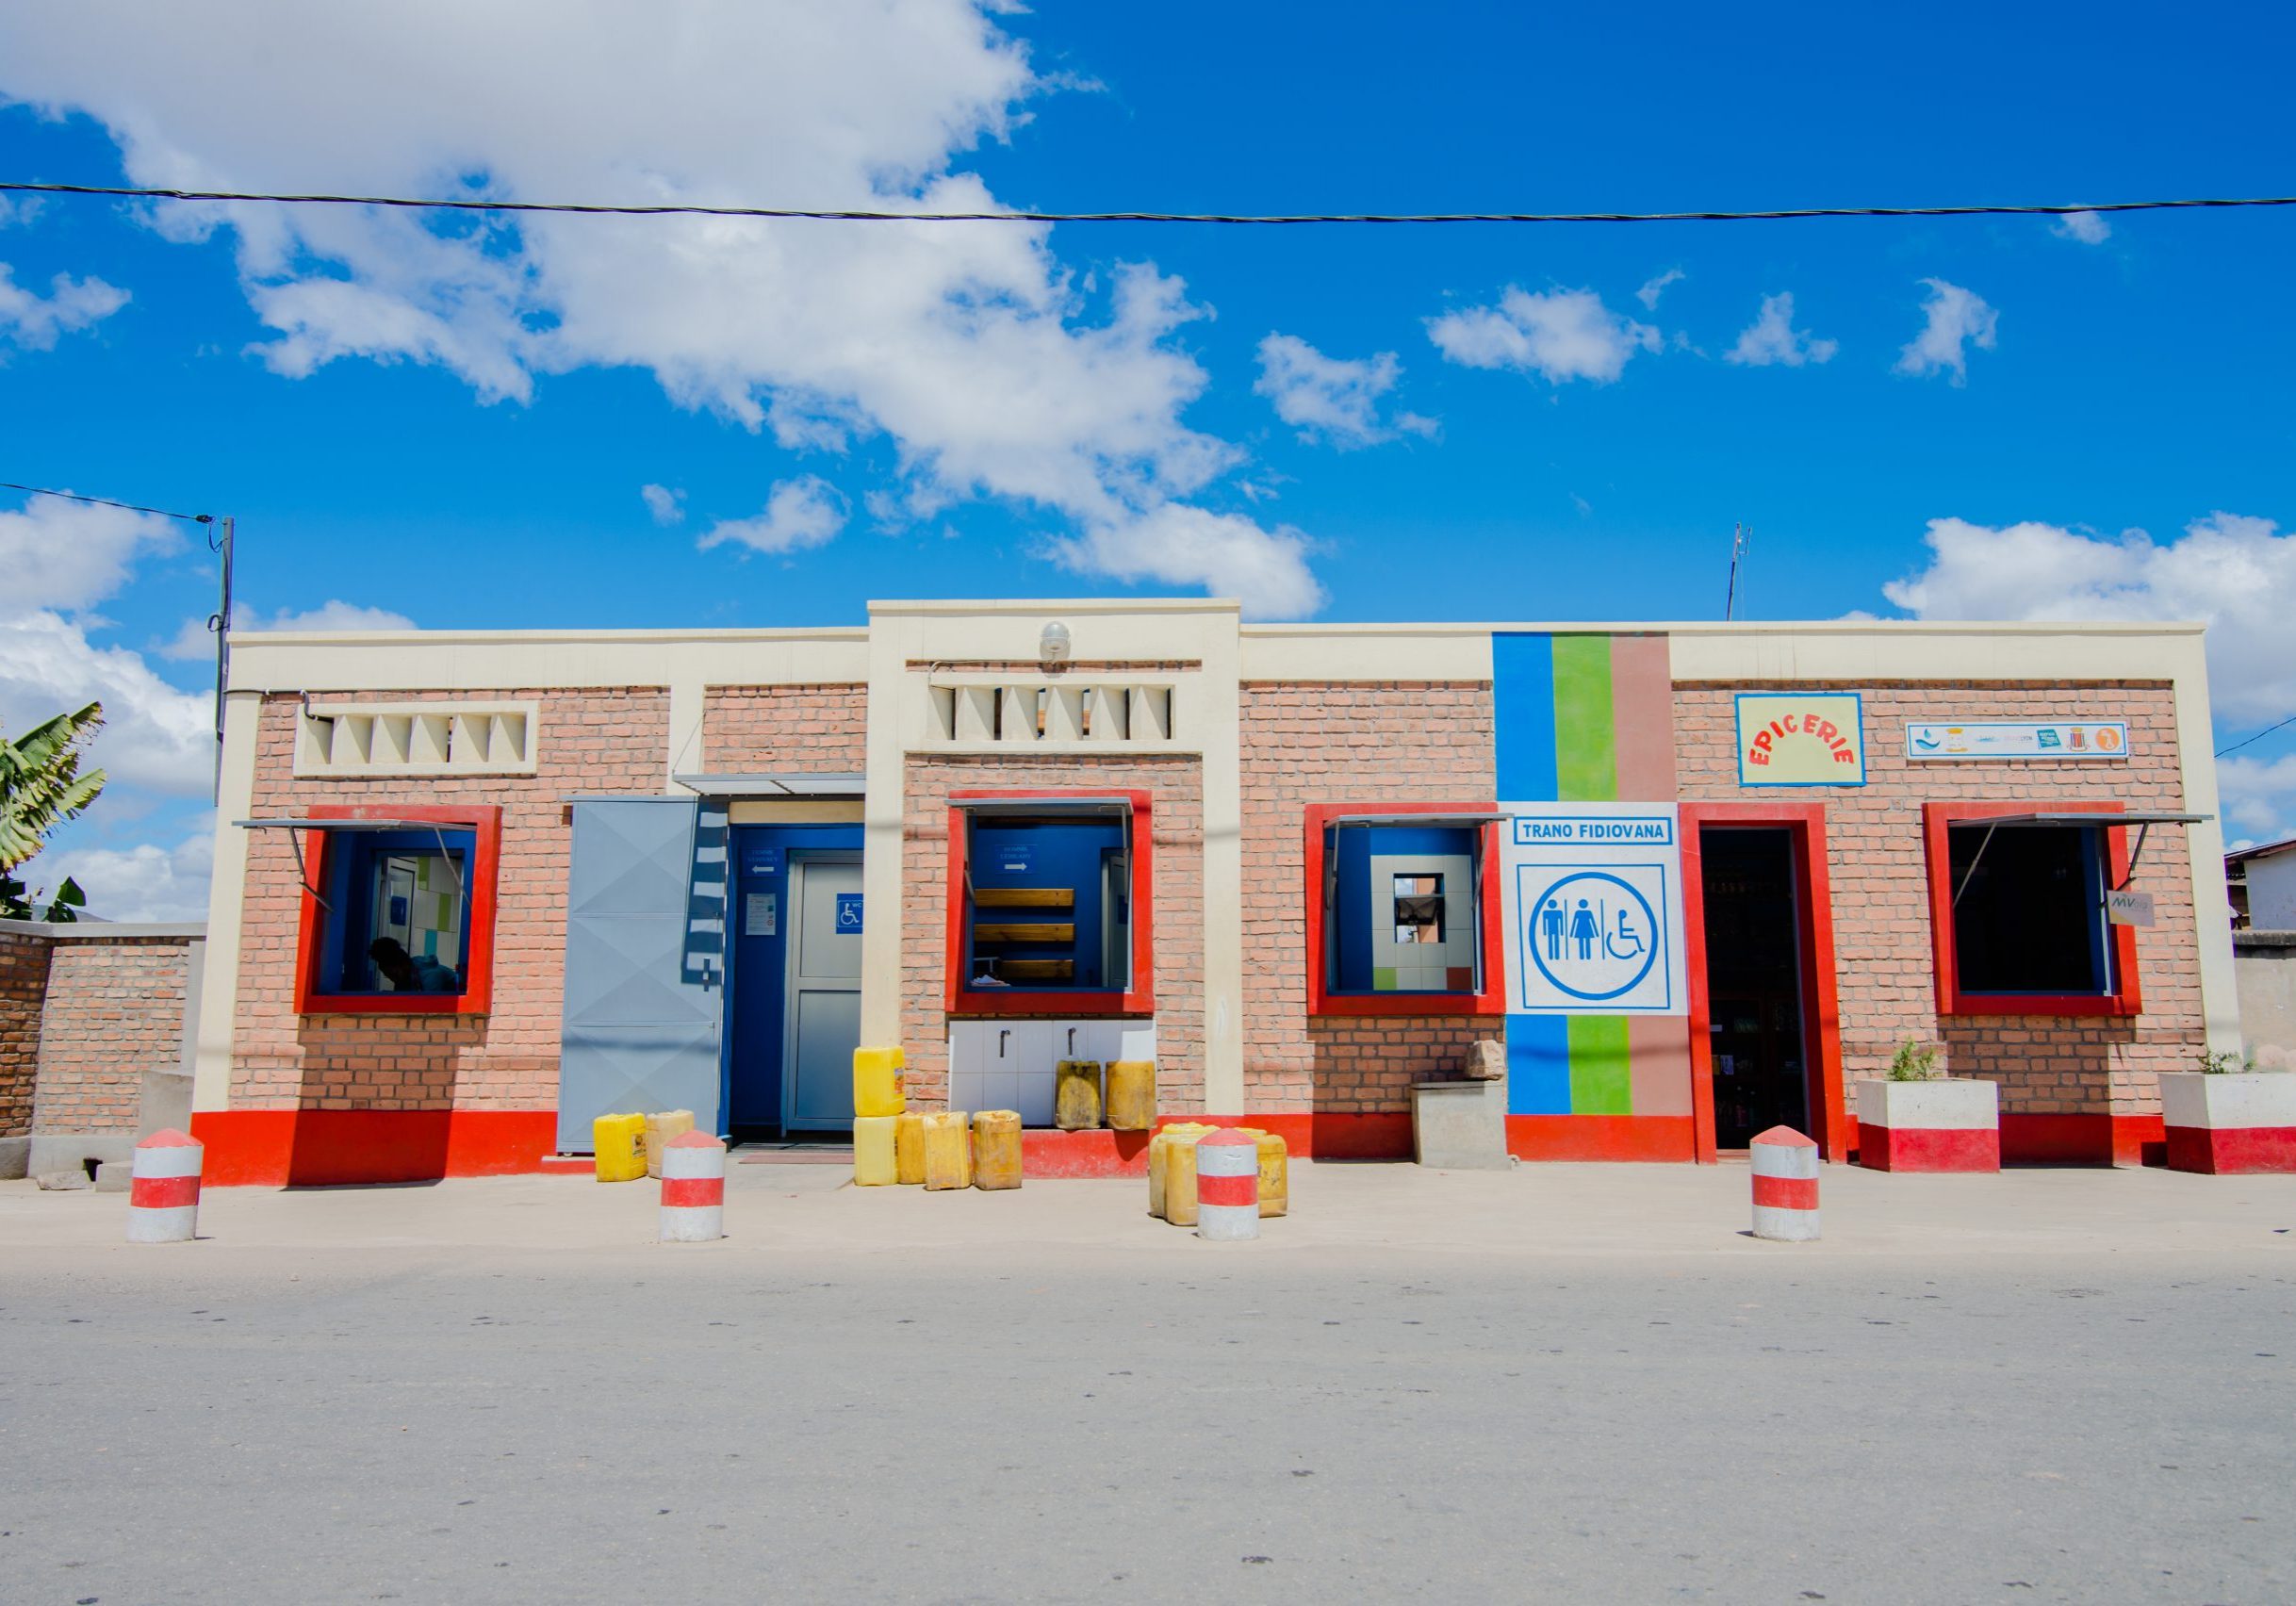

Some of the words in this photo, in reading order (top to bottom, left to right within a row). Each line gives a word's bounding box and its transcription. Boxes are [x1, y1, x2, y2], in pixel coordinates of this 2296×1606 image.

[1748, 713, 1854, 765] EPICERIE
[1523, 824, 1572, 838] TRANO
[1579, 824, 1664, 838] FIDIOVANA
